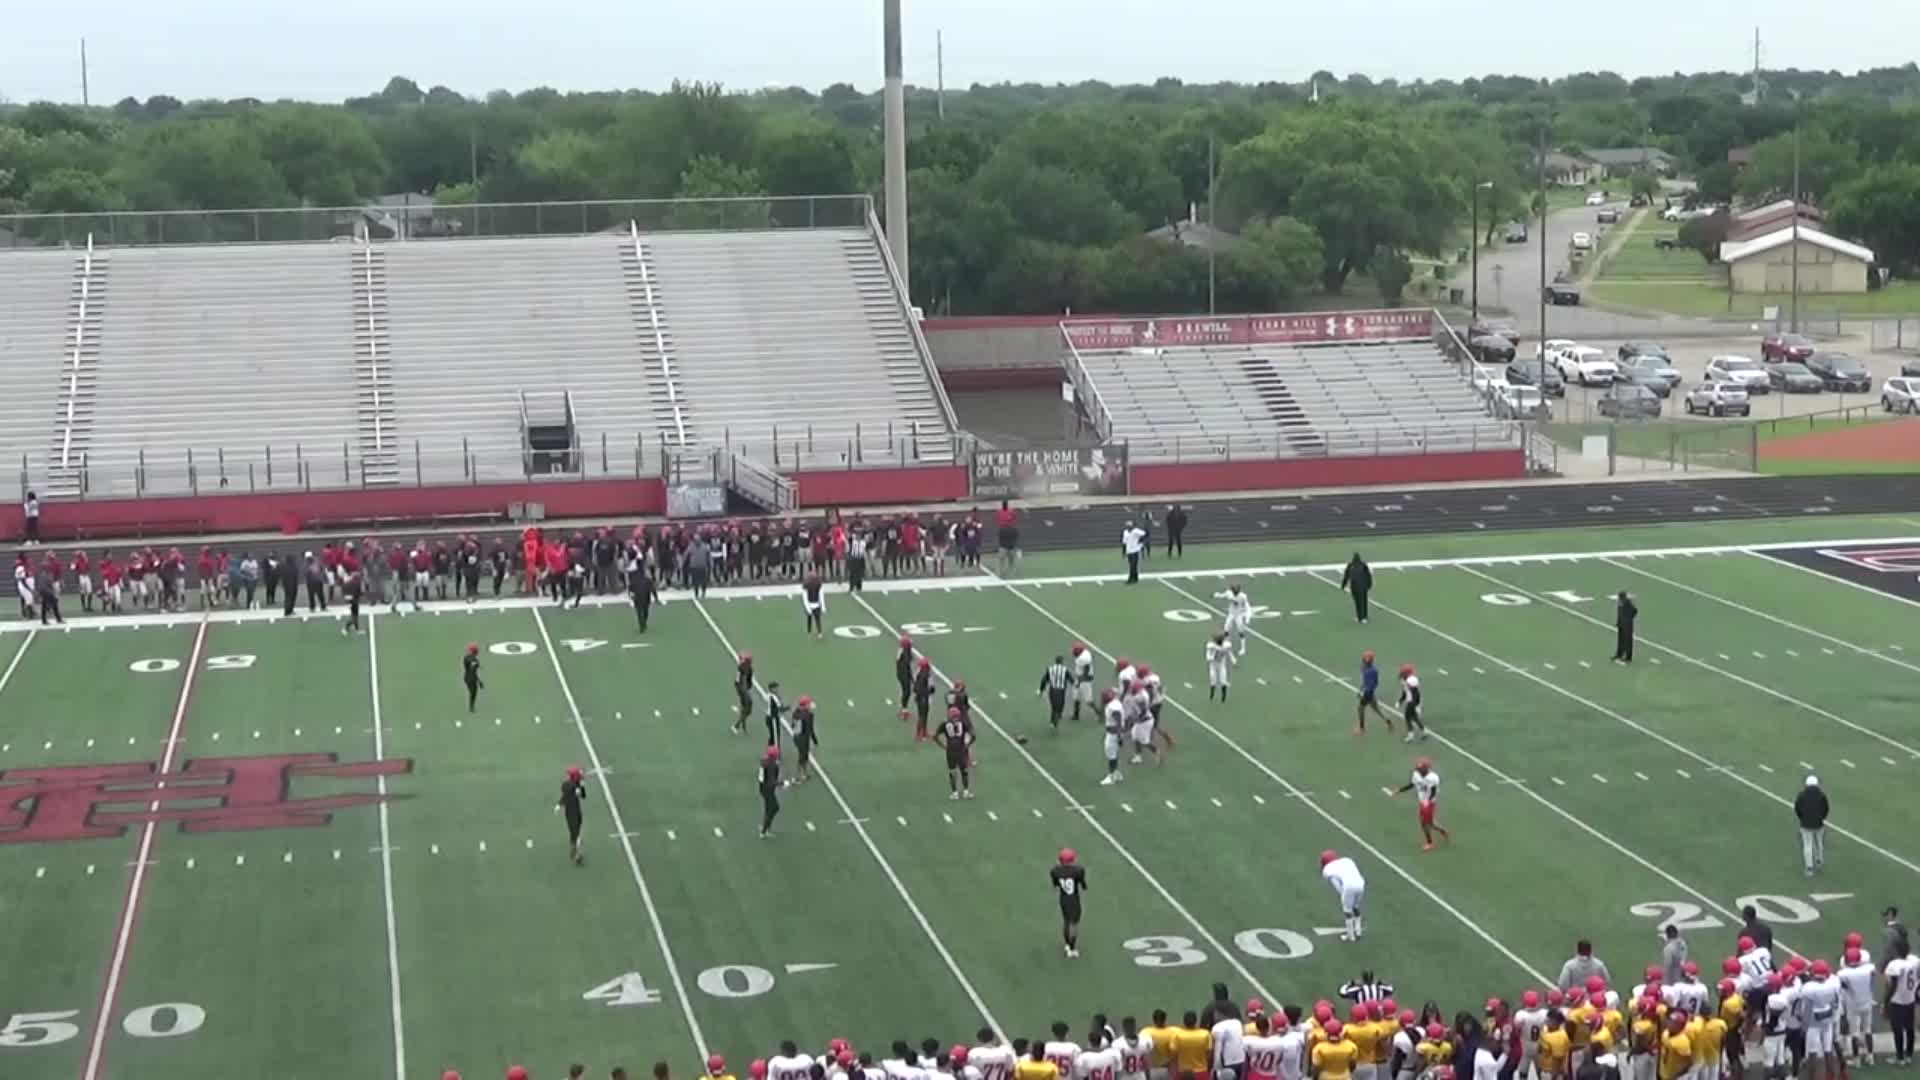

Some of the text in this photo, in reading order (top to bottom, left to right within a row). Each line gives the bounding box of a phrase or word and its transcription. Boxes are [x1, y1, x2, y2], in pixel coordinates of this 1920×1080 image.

[976, 466, 990, 477] OF
[993, 466, 1010, 477] THE
[1017, 451, 1038, 464] THE
[1043, 450, 1078, 464] HOME
[1046, 464, 1078, 475] WHITE
[1630, 894, 1820, 932] 20
[1122, 927, 1315, 967] 30
[582, 964, 775, 1007] 40
[0, 1002, 206, 1047] 50
